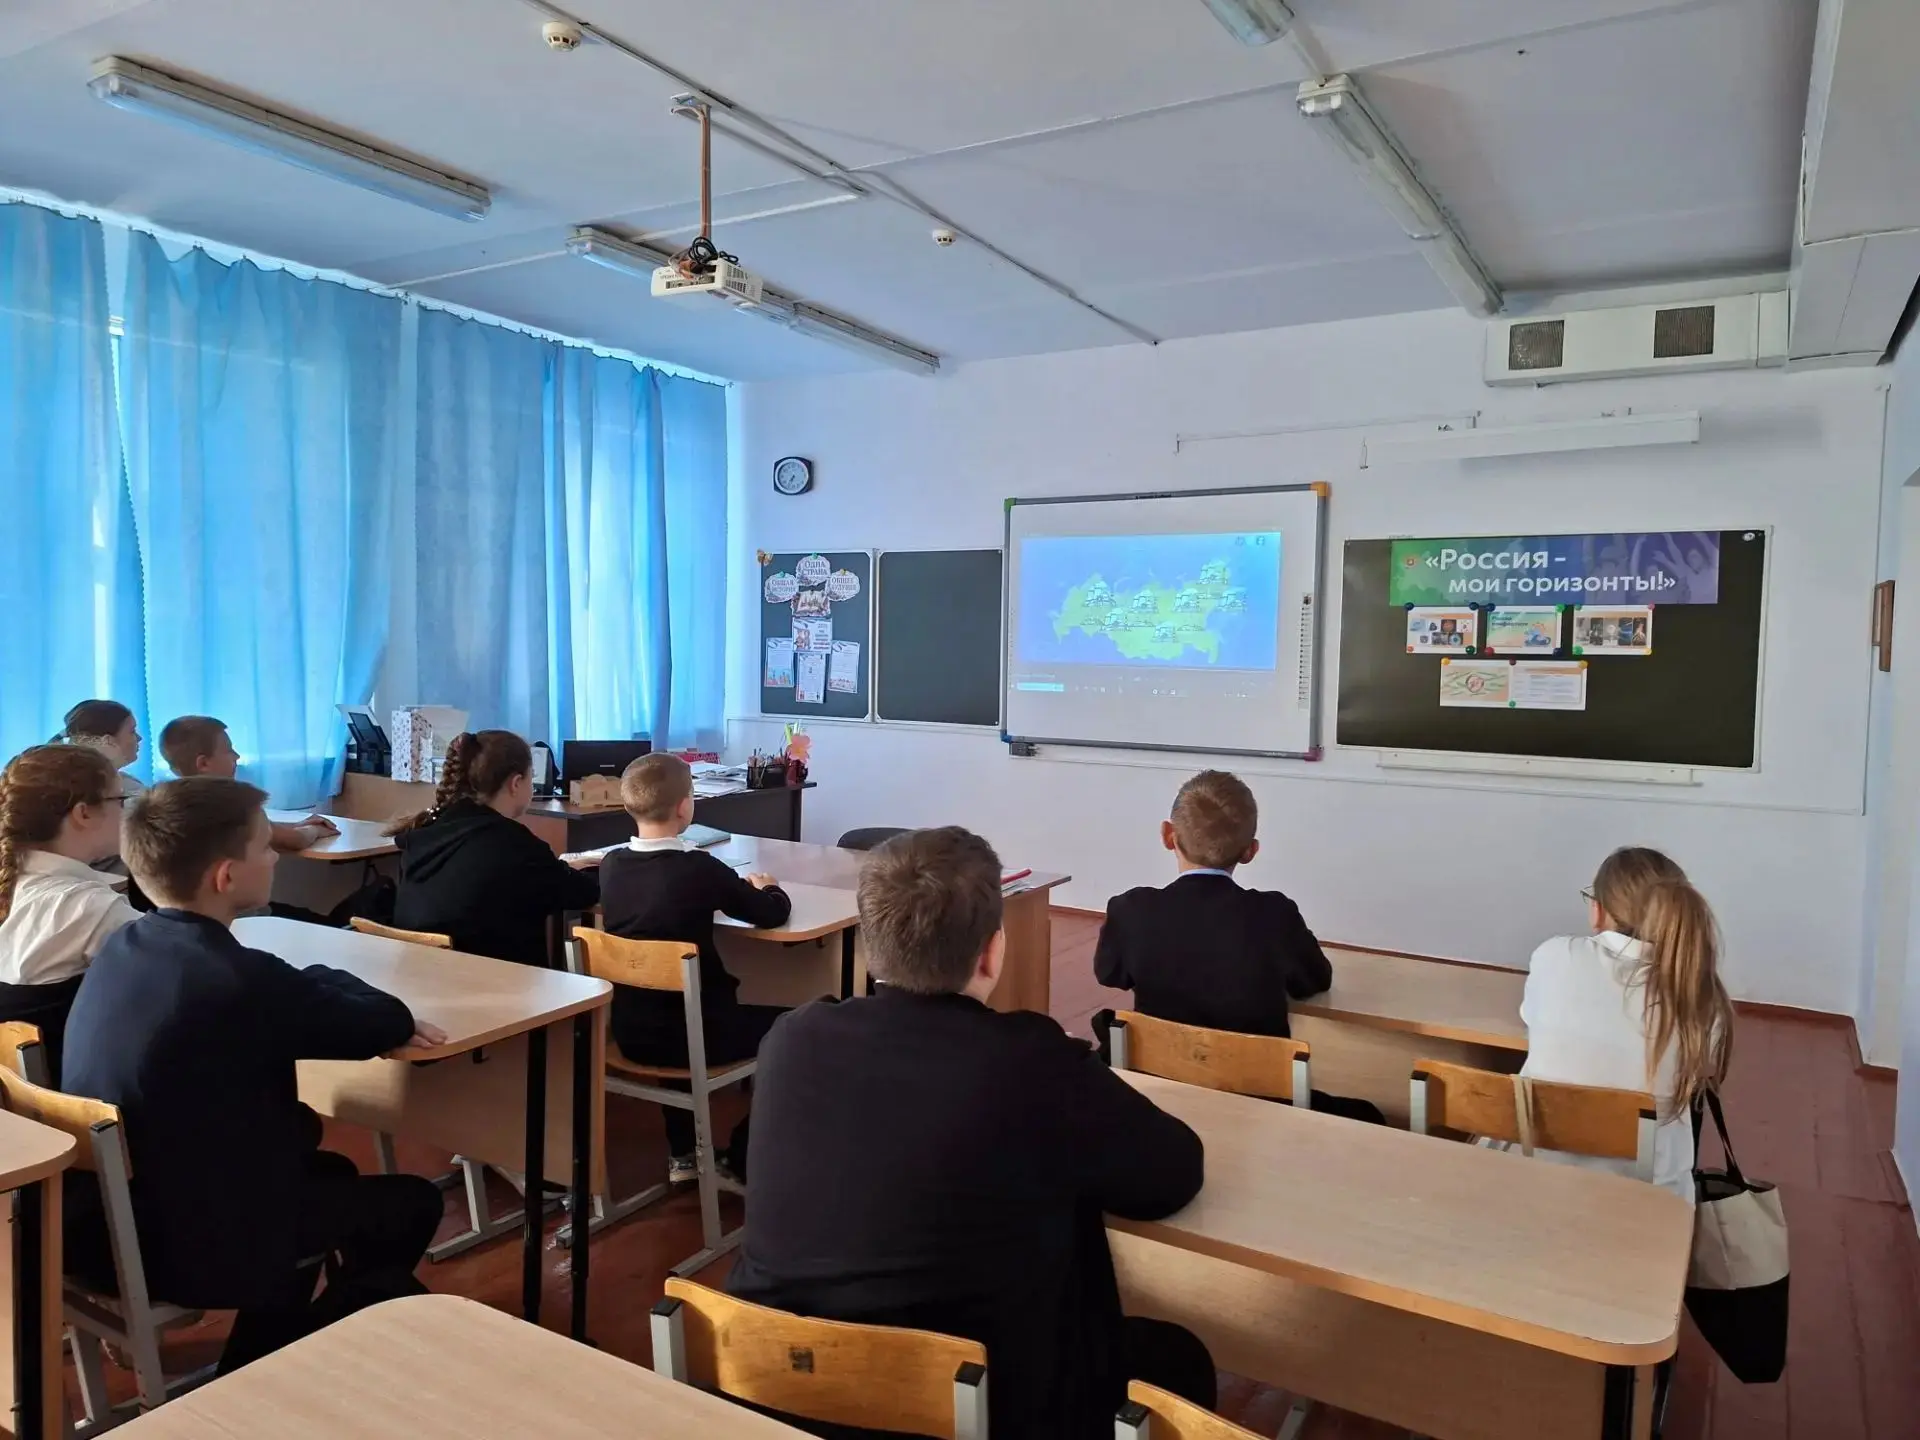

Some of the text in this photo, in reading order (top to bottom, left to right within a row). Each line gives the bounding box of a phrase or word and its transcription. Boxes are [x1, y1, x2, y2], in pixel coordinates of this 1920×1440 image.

[1425, 548, 1548, 571] «Россия
[1449, 571, 1676, 597] мои горизонты!»
